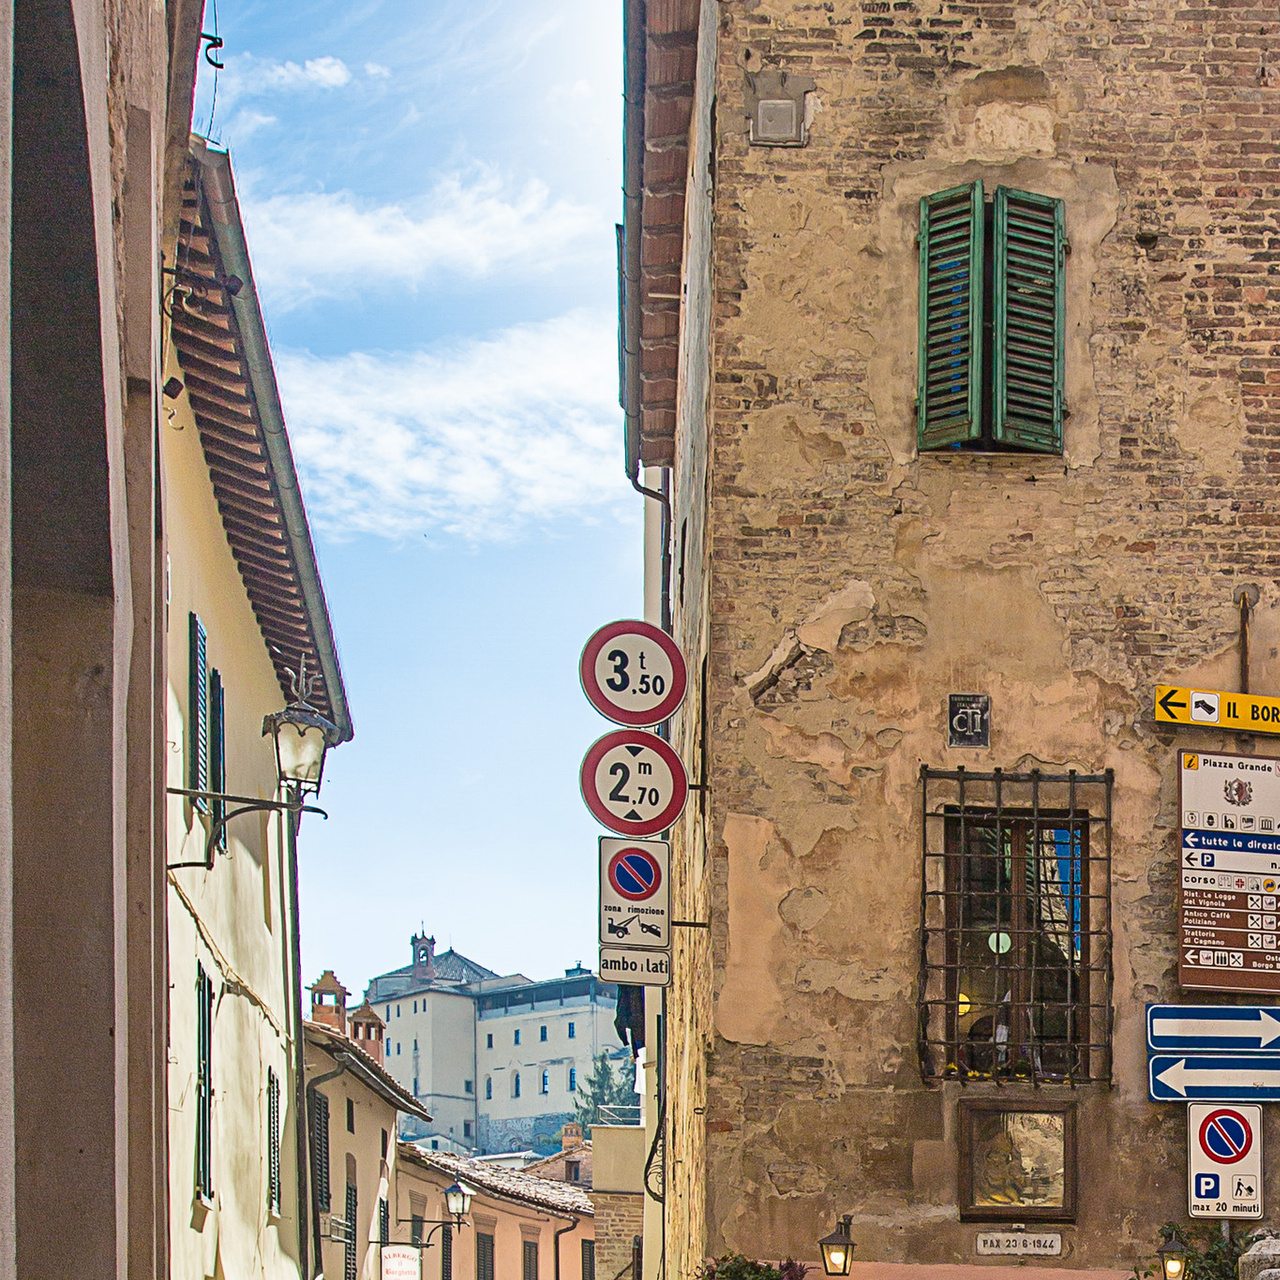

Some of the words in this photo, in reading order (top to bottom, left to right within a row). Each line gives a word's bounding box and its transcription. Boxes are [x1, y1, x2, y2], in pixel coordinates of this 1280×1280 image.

[1226, 701, 1239, 719] IL
[1202, 758, 1234, 769] Piazza
[1237, 761, 1273, 773] Grande
[1201, 836, 1229, 847] tutte
[1232, 838, 1243, 848] le
[1270, 862, 1280, 870] n.
[1183, 875, 1216, 885] corso
[1183, 890, 1201, 898] Rist.
[1203, 891, 1212, 899] Le
[1214, 892, 1237, 901] Logge
[1183, 898, 1196, 906] del
[1198, 899, 1226, 908] Vignola
[603, 904, 622, 913] zona
[627, 904, 665, 916] rimozione
[1183, 909, 1208, 918] Antico
[1183, 917, 1217, 926] Poliziano
[1183, 929, 1216, 938] Trattoria
[601, 956, 638, 972] ambo
[646, 958, 669, 974] lati
[1252, 960, 1274, 970] Borgo
[1192, 1203, 1210, 1212] max
[1215, 1202, 1228, 1213] 20
[1232, 1203, 1260, 1214] minuti
[982, 1239, 1001, 1249] PAX
[384, 1252, 418, 1263] ALBERGO
